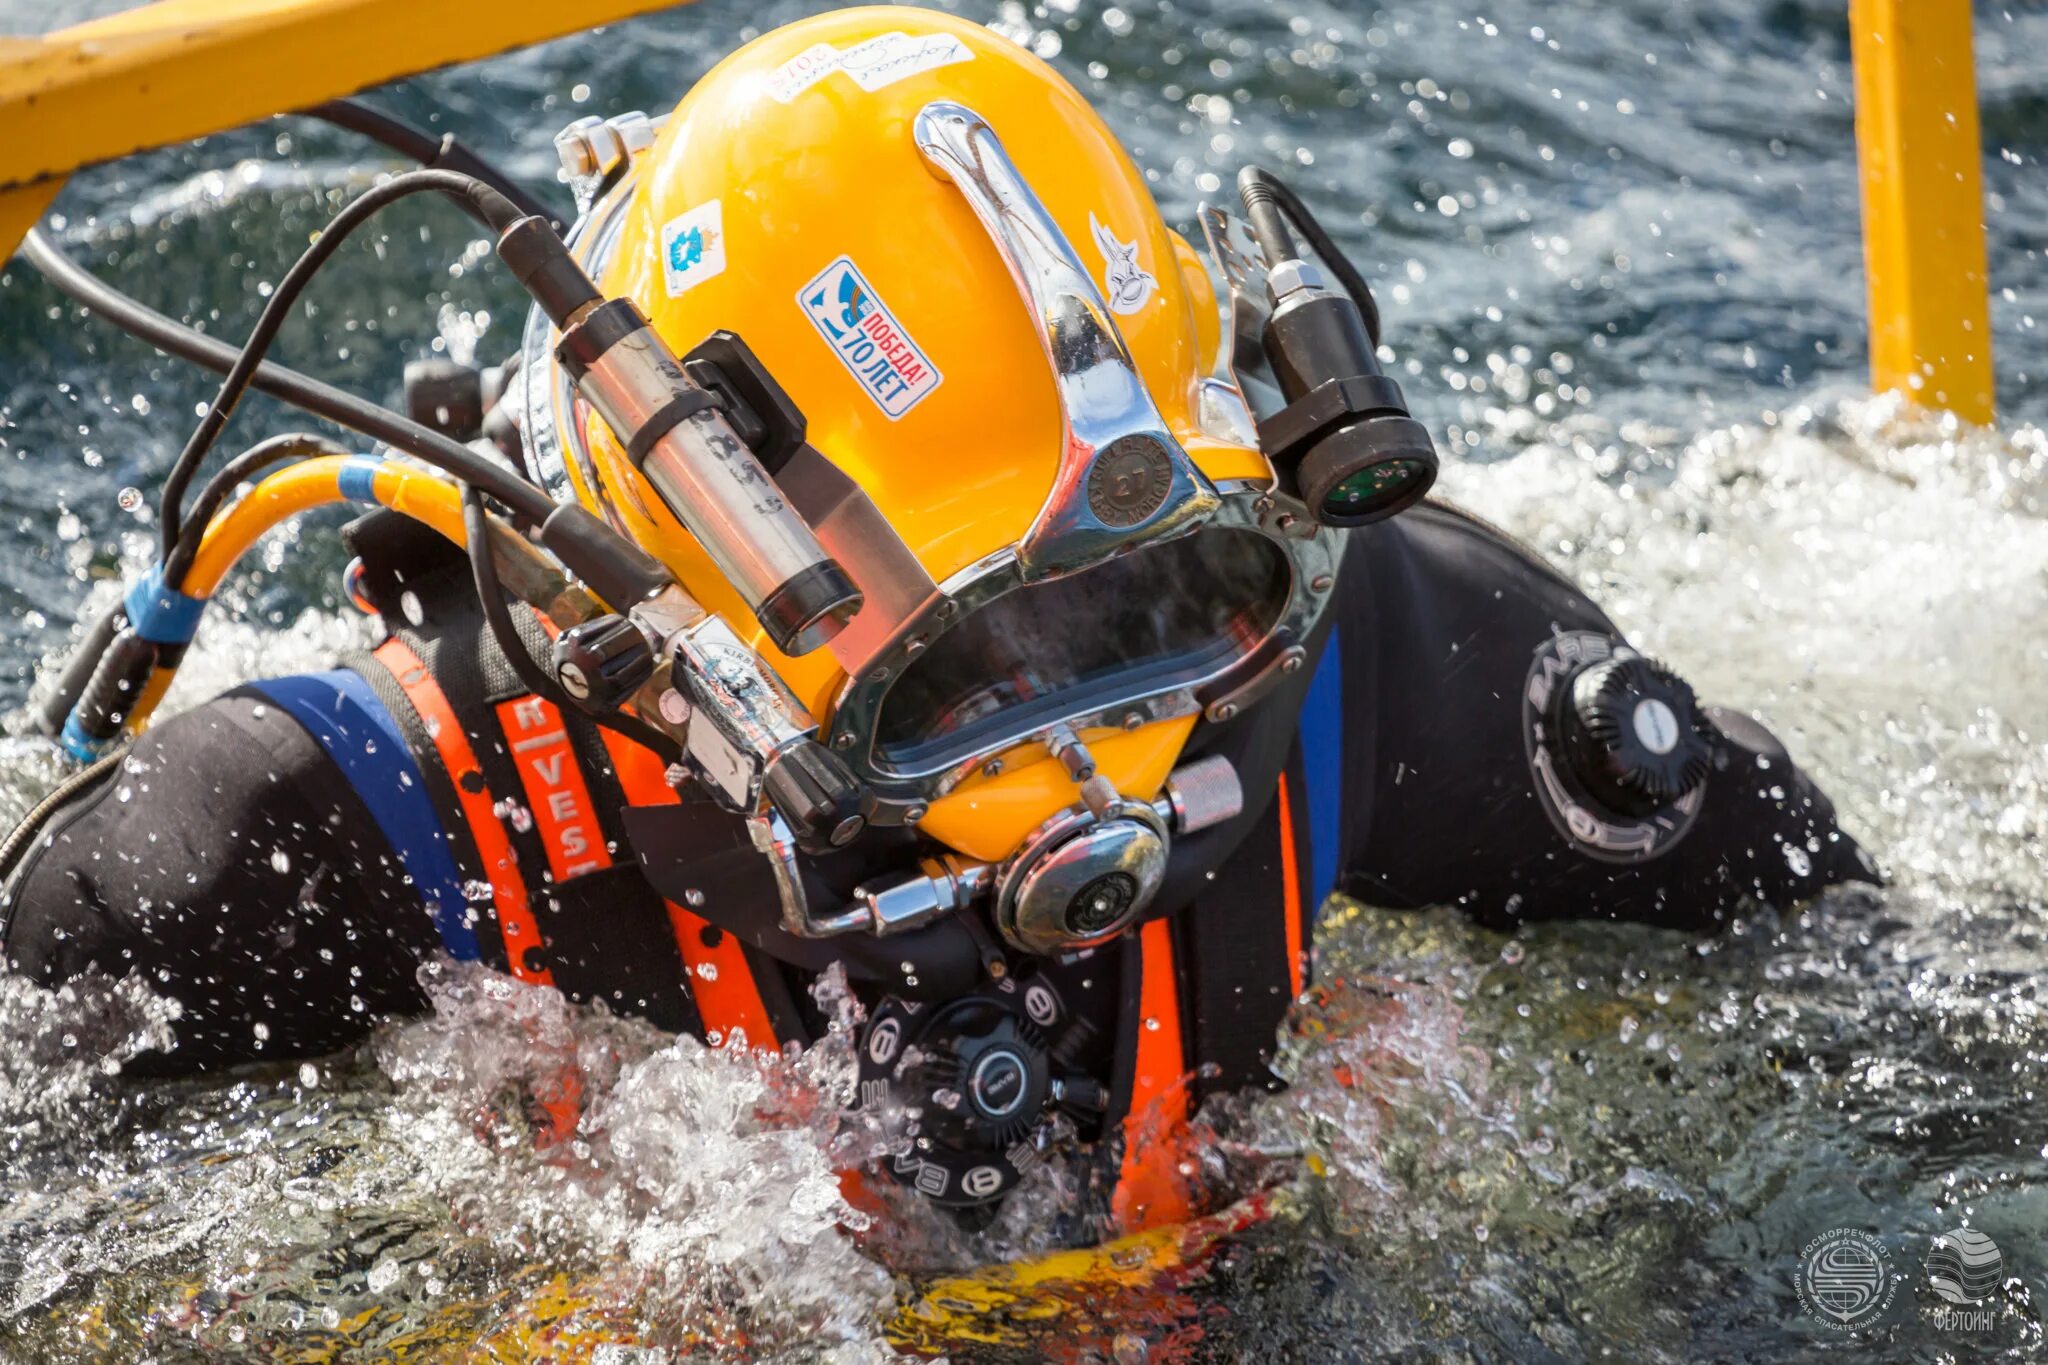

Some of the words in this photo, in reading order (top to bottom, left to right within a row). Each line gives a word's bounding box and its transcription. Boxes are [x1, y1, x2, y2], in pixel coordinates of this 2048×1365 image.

[842, 328, 875, 364] 70
[861, 358, 909, 402] ЛЕТ
[863, 312, 927, 386] ПОБЕДА!
